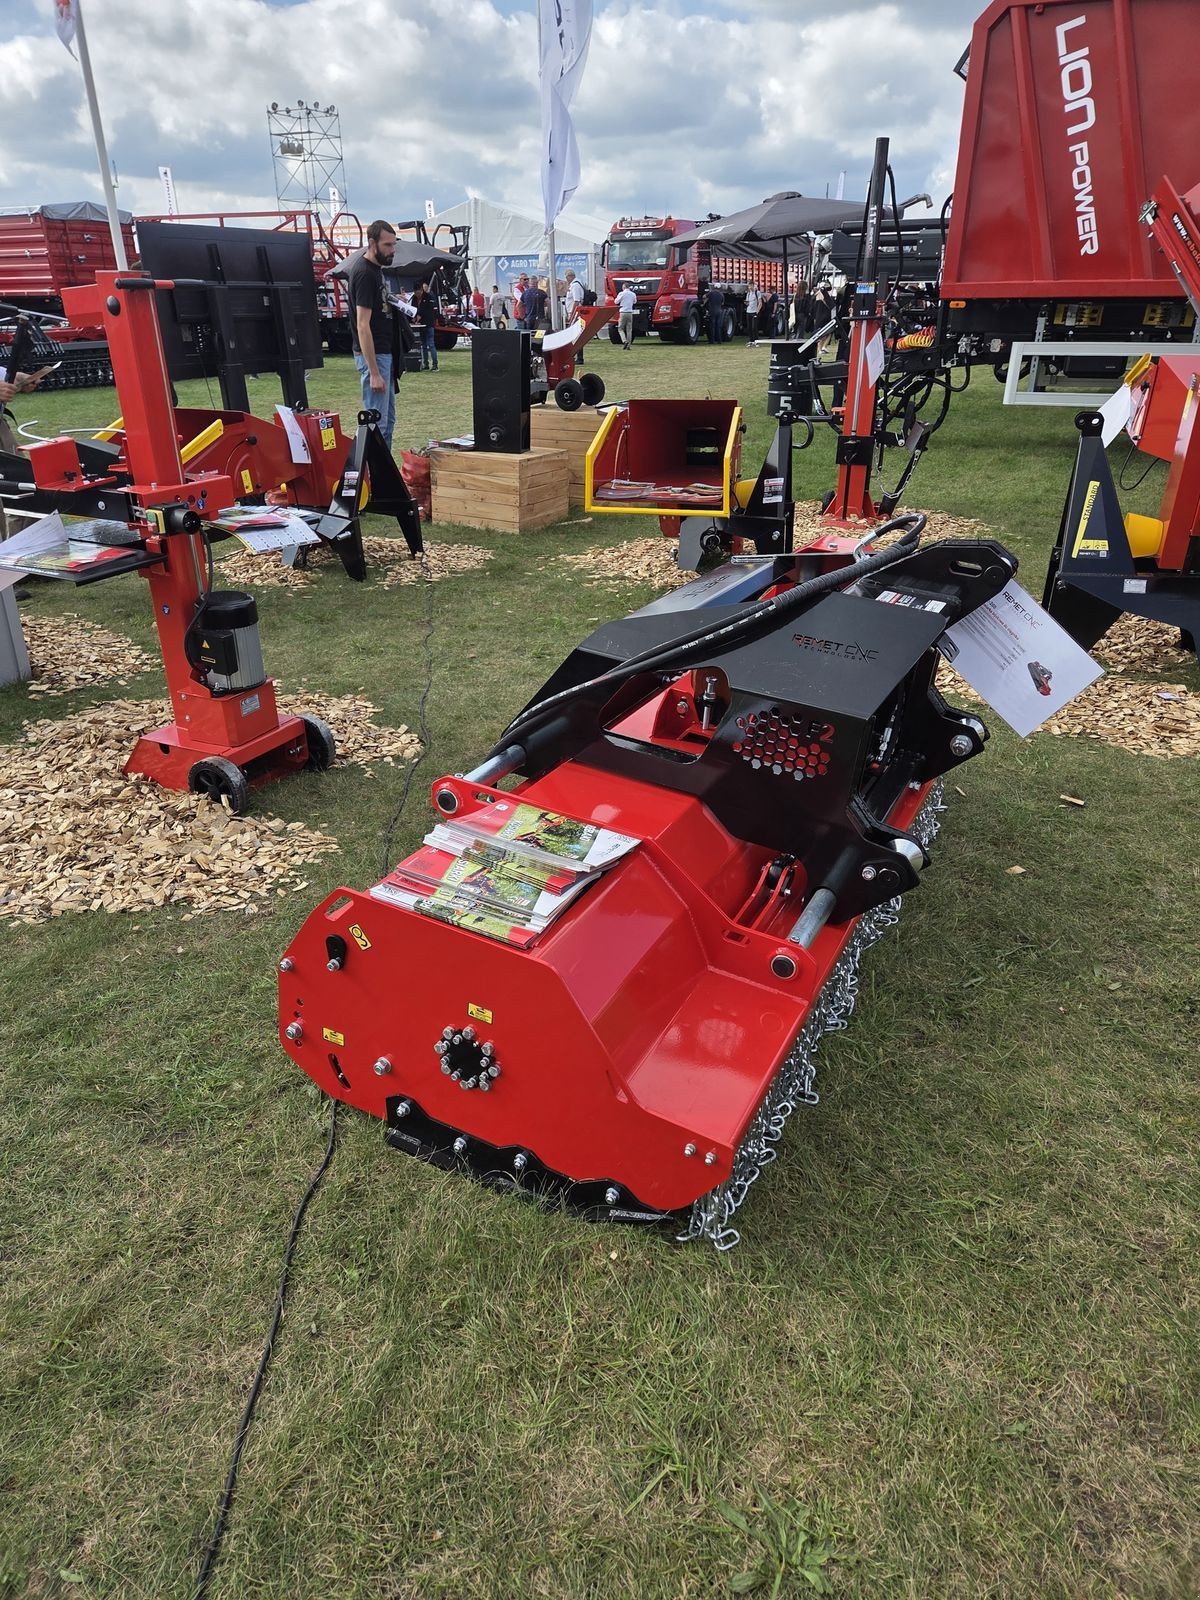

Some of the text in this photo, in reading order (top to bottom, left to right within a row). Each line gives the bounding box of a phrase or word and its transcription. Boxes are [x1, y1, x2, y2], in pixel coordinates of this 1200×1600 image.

[1068, 140, 1099, 256] POWER
[510, 259, 528, 268] AGRO
[1083, 484, 1099, 521] STANDARD
[1002, 590, 1027, 614] REMET
[792, 633, 844, 651] REMET
